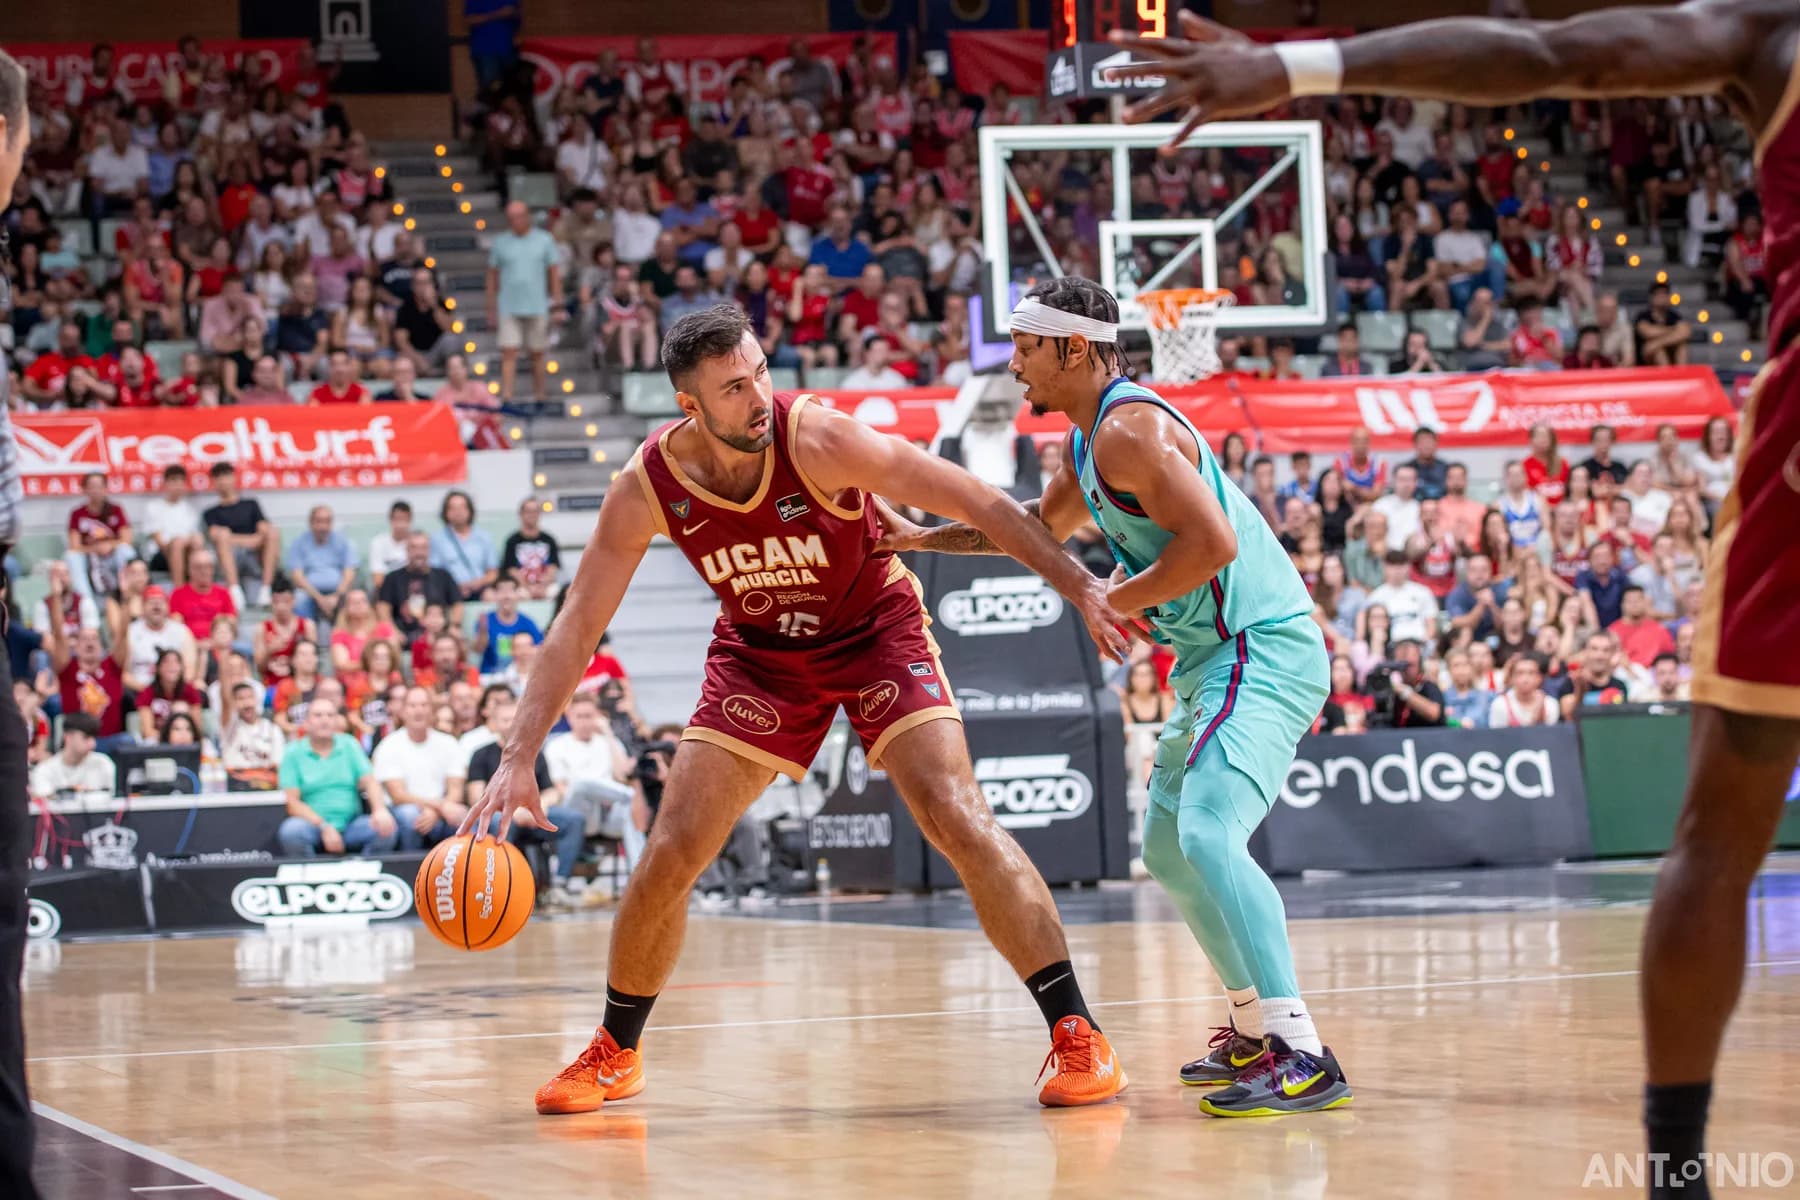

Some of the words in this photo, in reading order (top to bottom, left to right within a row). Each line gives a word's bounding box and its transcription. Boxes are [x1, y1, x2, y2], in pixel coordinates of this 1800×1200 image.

[1137, 0, 1166, 39] 9
[107, 416, 395, 467] realturf
[700, 534, 830, 584] UCAM
[730, 569, 820, 597] MURCIA
[776, 611, 821, 637] 15
[726, 700, 775, 729] Juver
[863, 686, 892, 717] Juver
[1279, 738, 1554, 809] endesa
[435, 843, 464, 922] Wilson
